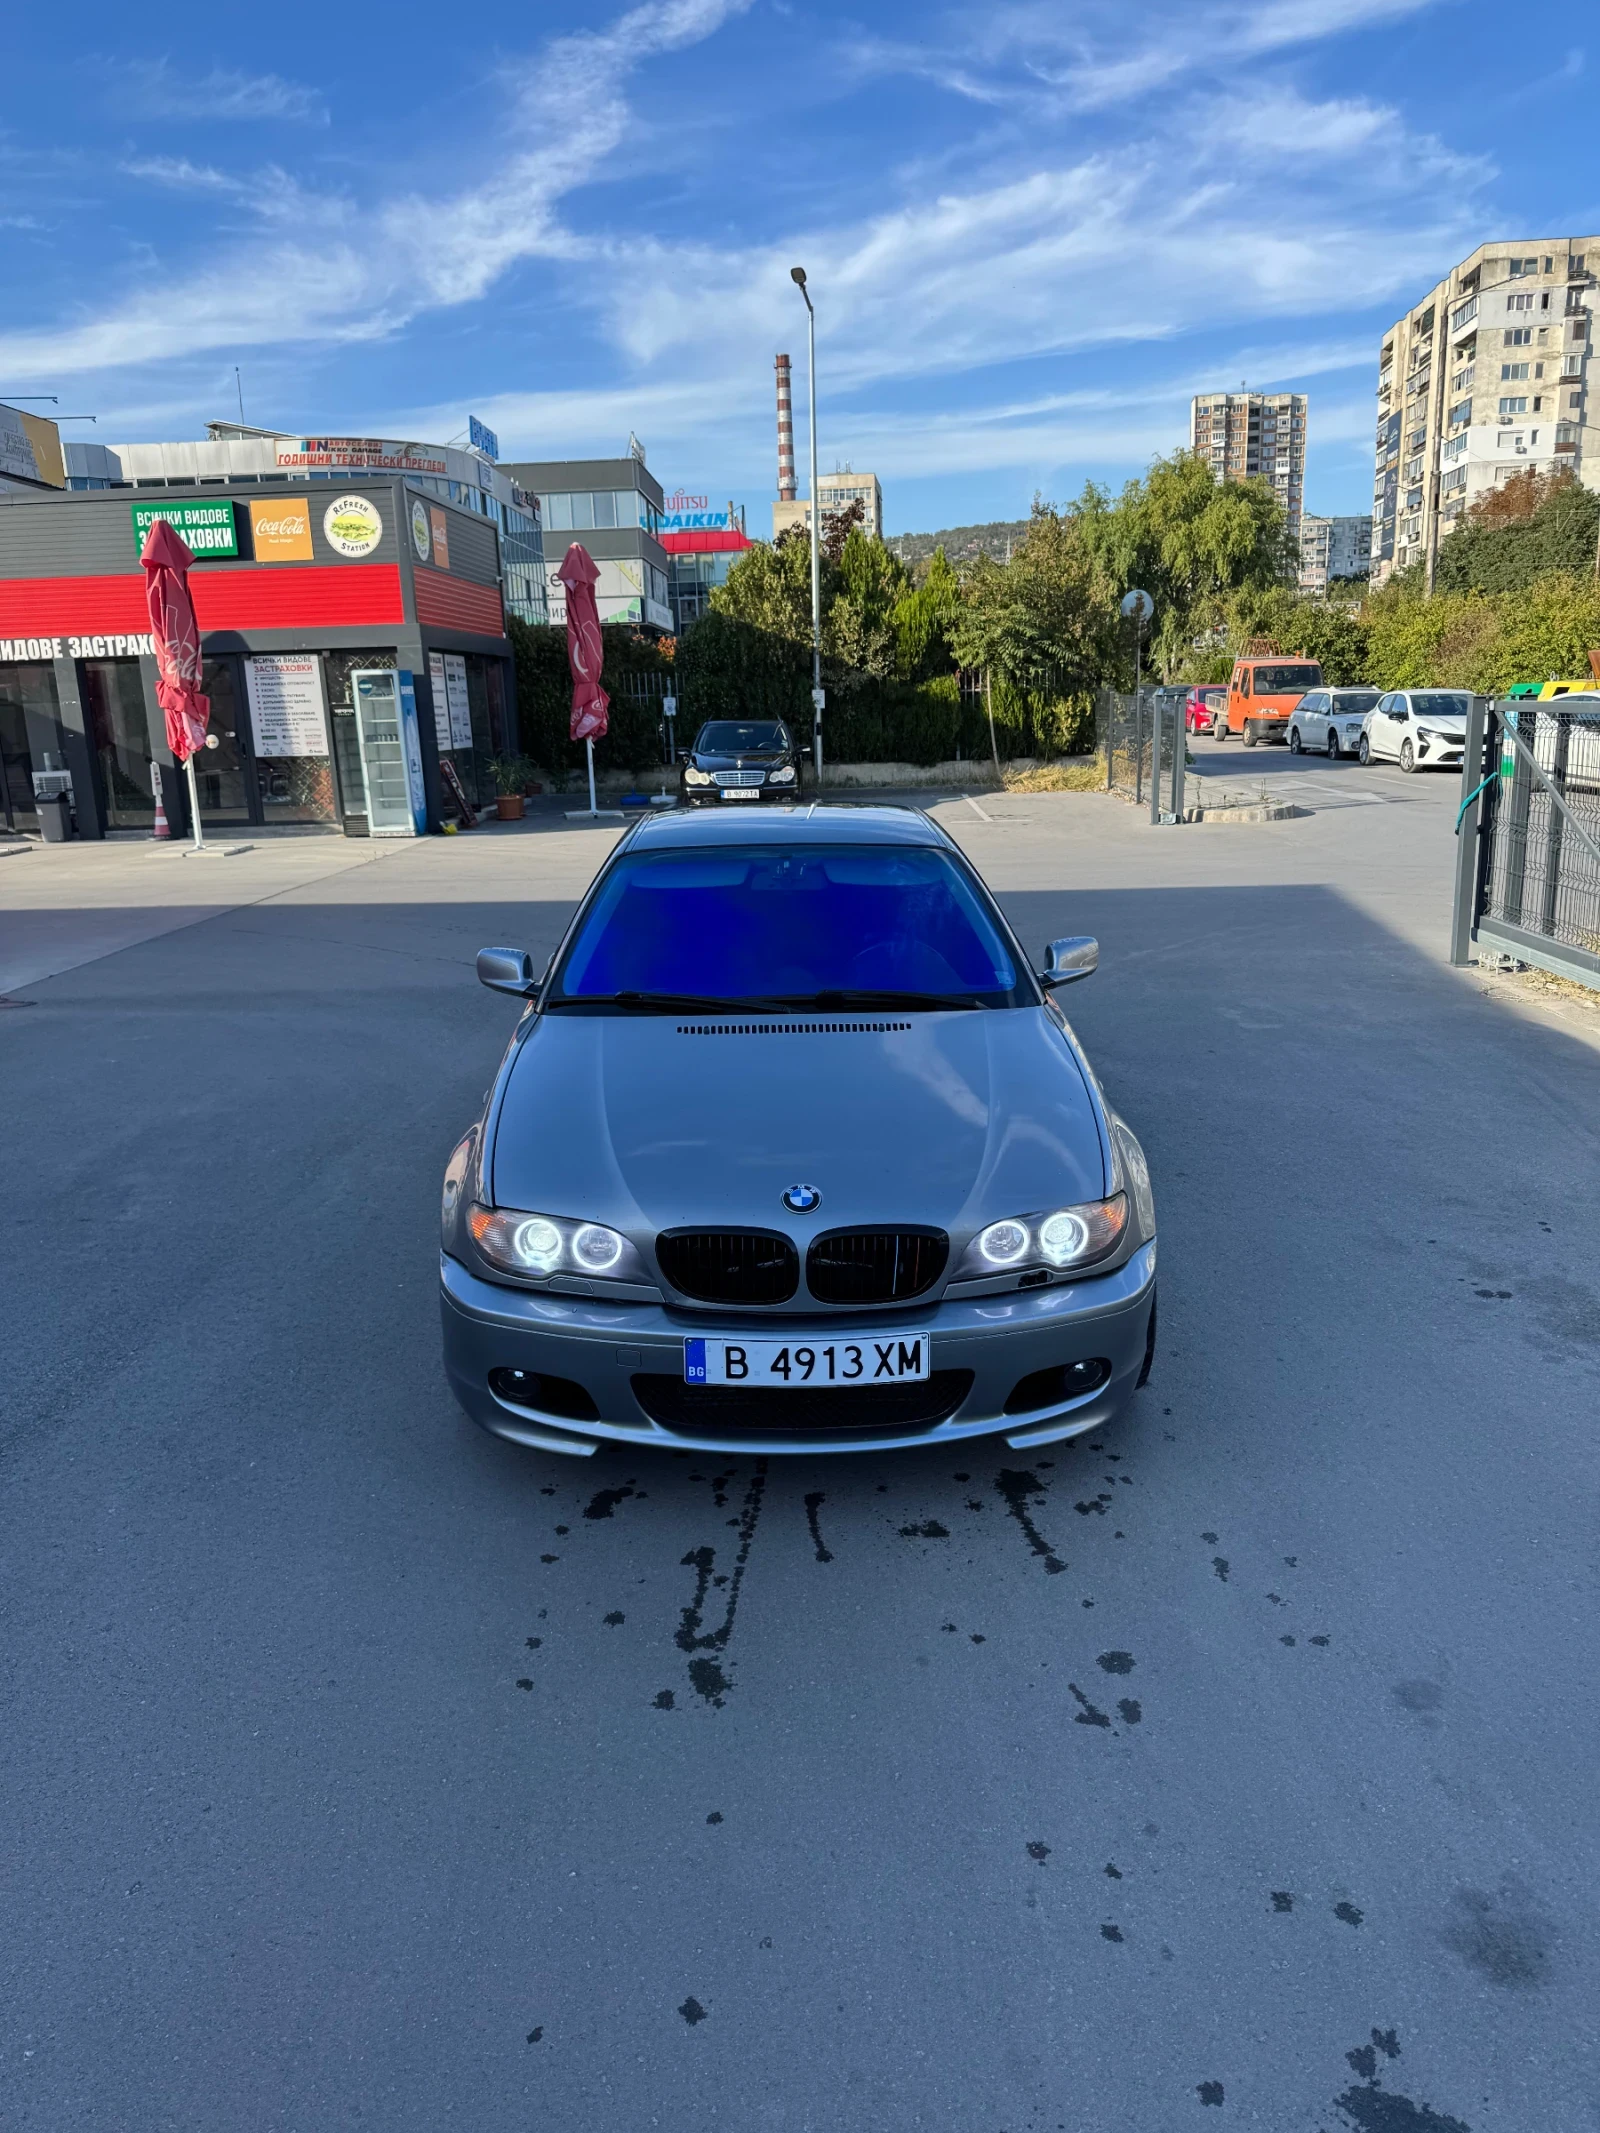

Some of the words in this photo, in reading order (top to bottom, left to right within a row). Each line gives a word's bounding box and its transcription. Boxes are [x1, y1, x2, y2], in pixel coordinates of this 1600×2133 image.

[329, 440, 383, 448] АВТОСЕРВИЗ
[279, 453, 332, 465] ГОДИШНИ
[336, 454, 403, 467] ТЕХНИЧЕСКИ
[405, 458, 446, 473] ПРЕГЛЕДИ
[184, 508, 230, 525] ВИДОВЕ
[255, 516, 306, 536] Coca-Cola
[659, 513, 729, 528] DAIKIN
[138, 527, 233, 551] ЗАХОВКИ
[0, 636, 63, 662] ИДОВЕ
[254, 664, 313, 673] ЗАСТРАХОВКИ
[688, 1366, 704, 1377] BG
[725, 1346, 748, 1379] B
[770, 1346, 864, 1380] 4913
[873, 1340, 921, 1378] XM
